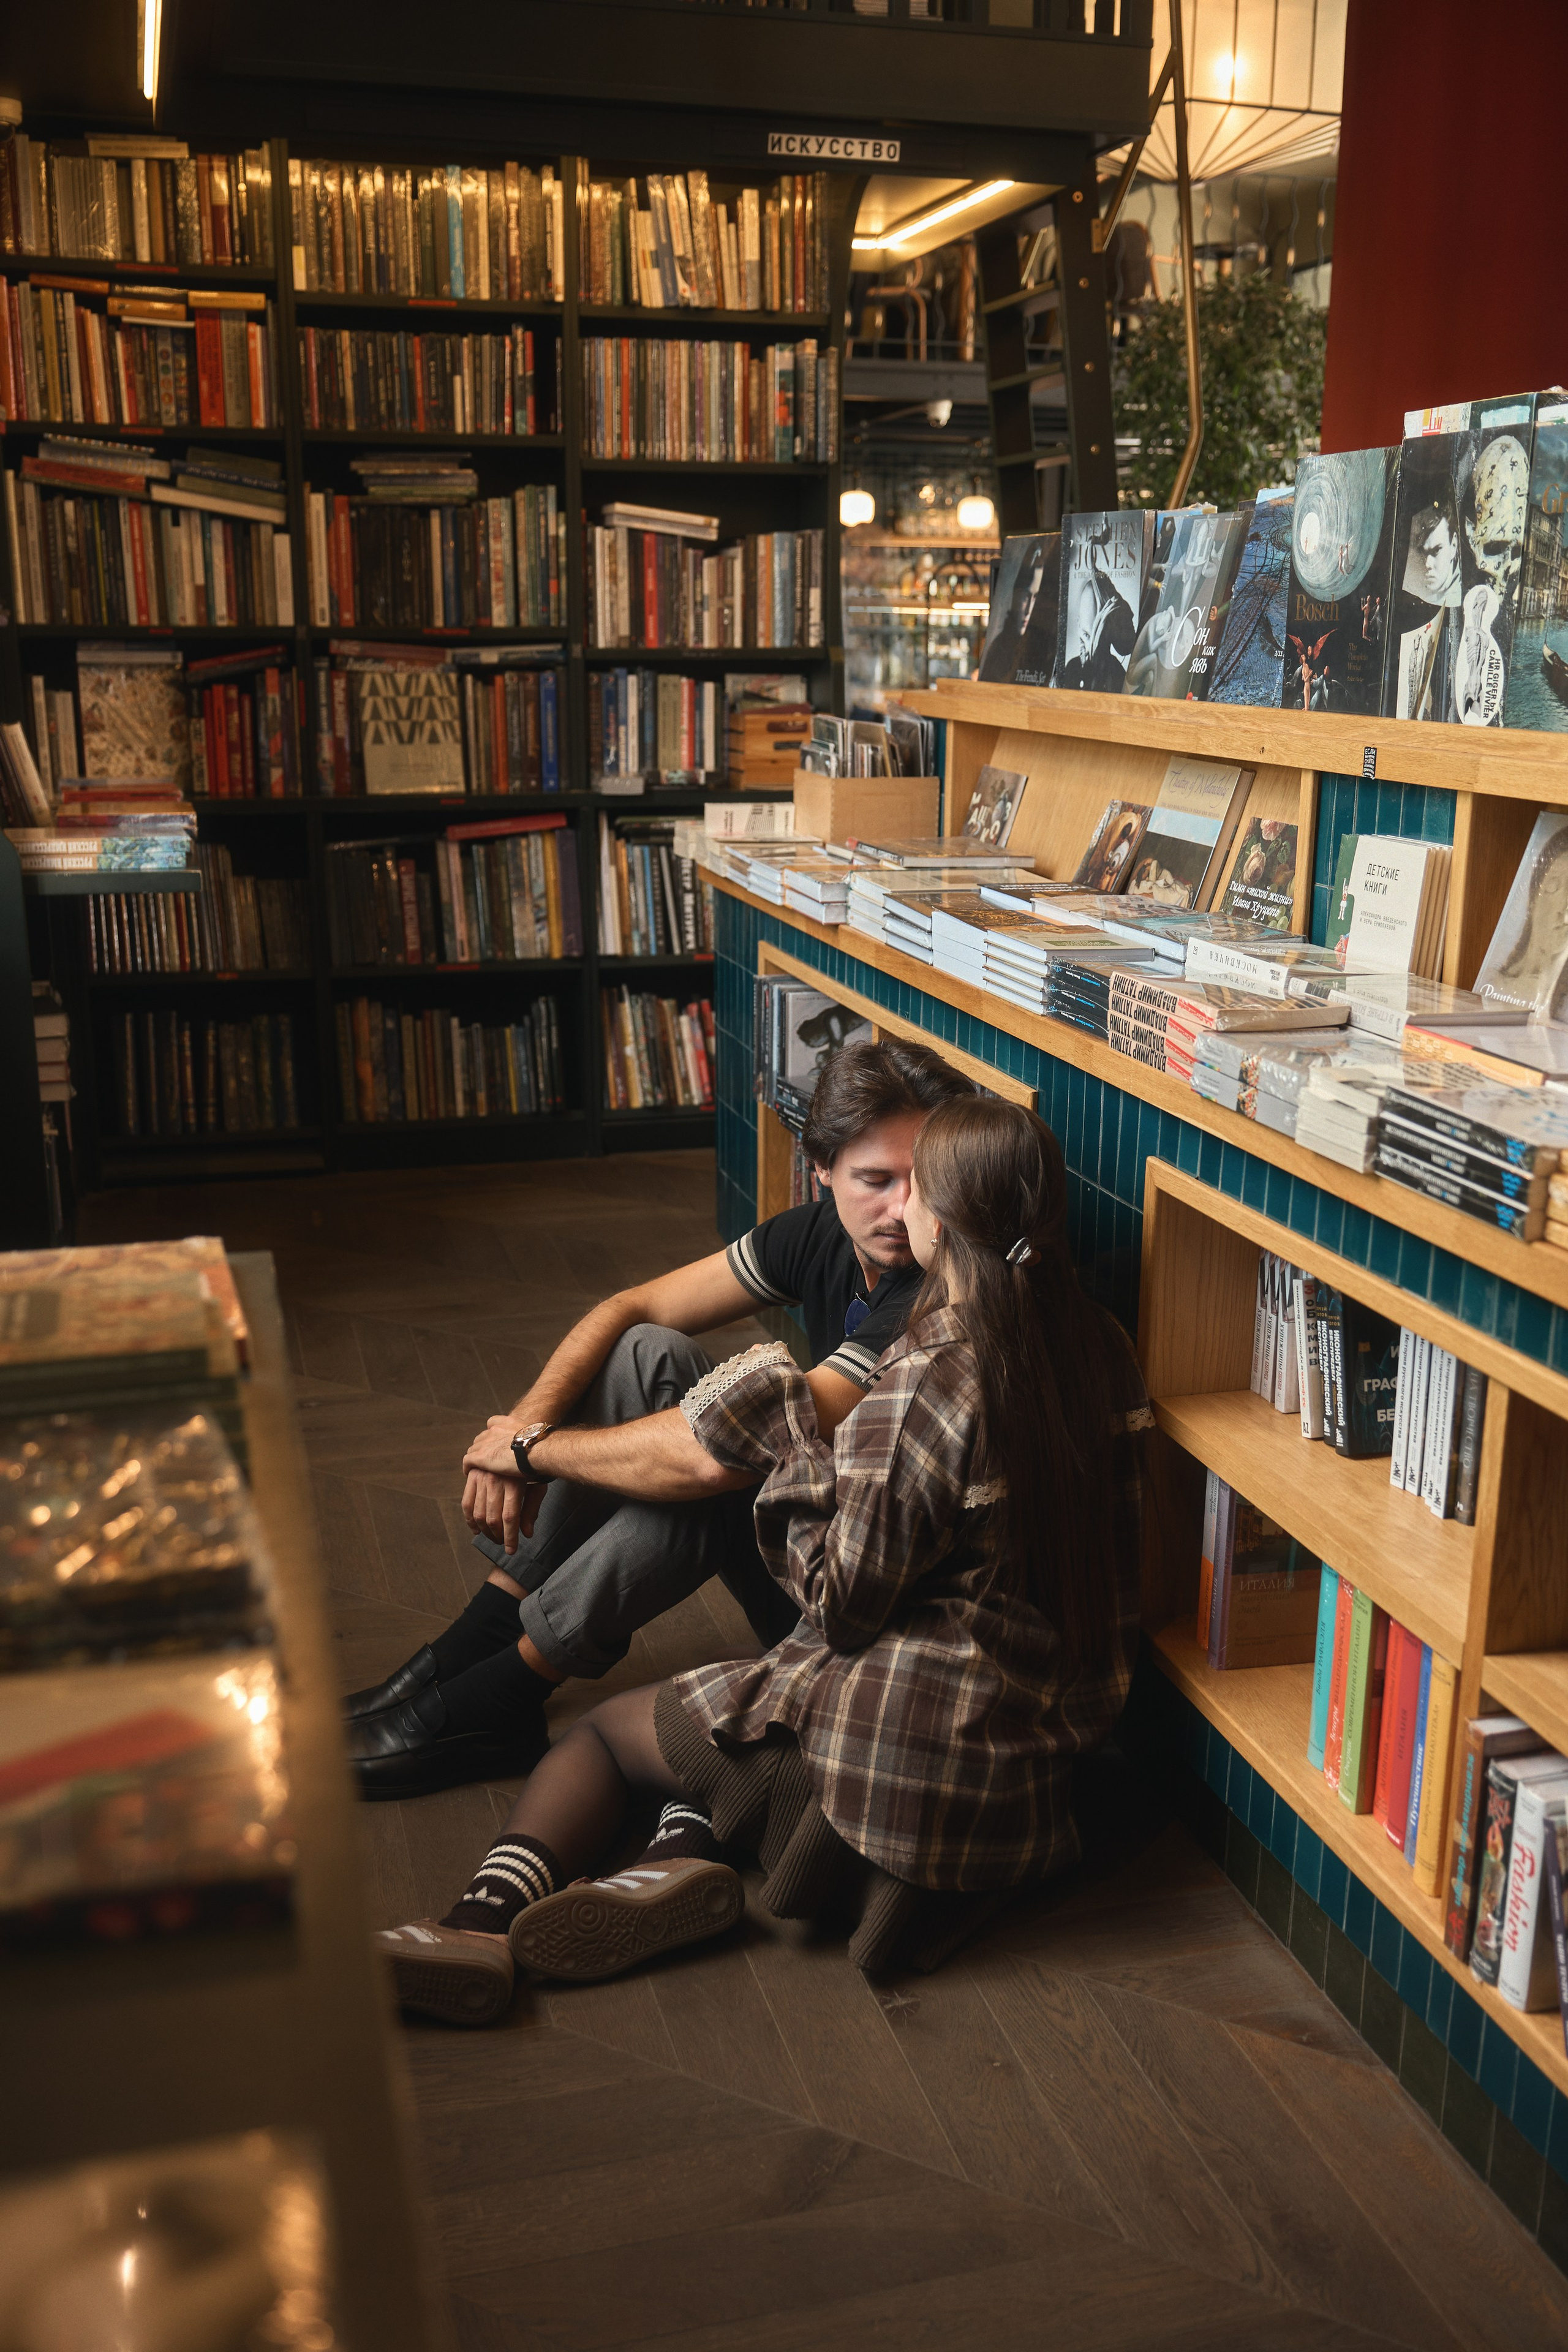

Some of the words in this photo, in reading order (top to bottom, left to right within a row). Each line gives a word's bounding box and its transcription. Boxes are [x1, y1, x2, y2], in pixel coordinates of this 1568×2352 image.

[771, 135, 897, 159] ИСКУССТВО
[1074, 541, 1136, 570] JONES
[1294, 594, 1340, 621] Bosch
[1171, 606, 1210, 668] Сон
[1202, 646, 1216, 656] как
[1486, 649, 1496, 688] CAMILLE
[1494, 658, 1501, 671] HR
[1490, 673, 1499, 699] GIGER
[1483, 690, 1492, 718] VIVIER
[1366, 863, 1400, 881] ДЕТСКИЕ
[1229, 881, 1247, 893] Гимн
[1246, 886, 1271, 899] «тихой
[1267, 892, 1293, 905] жизни»
[1363, 880, 1387, 895] КНИГИ
[1232, 895, 1251, 910] Ивана
[1250, 901, 1280, 921] Хруцкого
[1209, 951, 1258, 974] МОСКВИЧКА
[1112, 974, 1138, 998] ТАТЛИН
[1137, 984, 1178, 1014] ВЛАДИМИР
[1111, 993, 1133, 1018] ТАТЛИН
[1133, 1004, 1168, 1033] ВЛАДИМИР
[1109, 1014, 1131, 1038] ТАТЛИН
[1131, 1024, 1165, 1054] ВЛАДИМИР
[1110, 1032, 1132, 1057] ТАТЛИН
[1133, 1043, 1167, 1072] ВЛАДИМИР
[1322, 1321, 1331, 1416] ИКОНОГРАФИЧЕСКИЙ
[1333, 1330, 1346, 1426] ИКОНОГРАФИЧЕСКИЙ
[1303, 1421, 1310, 1434] AZ
[1240, 1578, 1295, 1591] ИТАЛИЯ
[1317, 1621, 1326, 1666] РАФАЭЛЯ
[1351, 1619, 1362, 1662] ИТАЛИИ
[1315, 1667, 1325, 1695] Банда
[1347, 1664, 1359, 1739] СОВРЕМЕННОЙ
[1329, 1706, 1339, 1743] Венера
[1397, 1707, 1409, 1760] ИТАЛИЯ
[1409, 1743, 1423, 1826] Путешествие
[1458, 1752, 1475, 1853] scandinavian
[1453, 1855, 1466, 1907] design
[1505, 1841, 1536, 1953] Fashion
